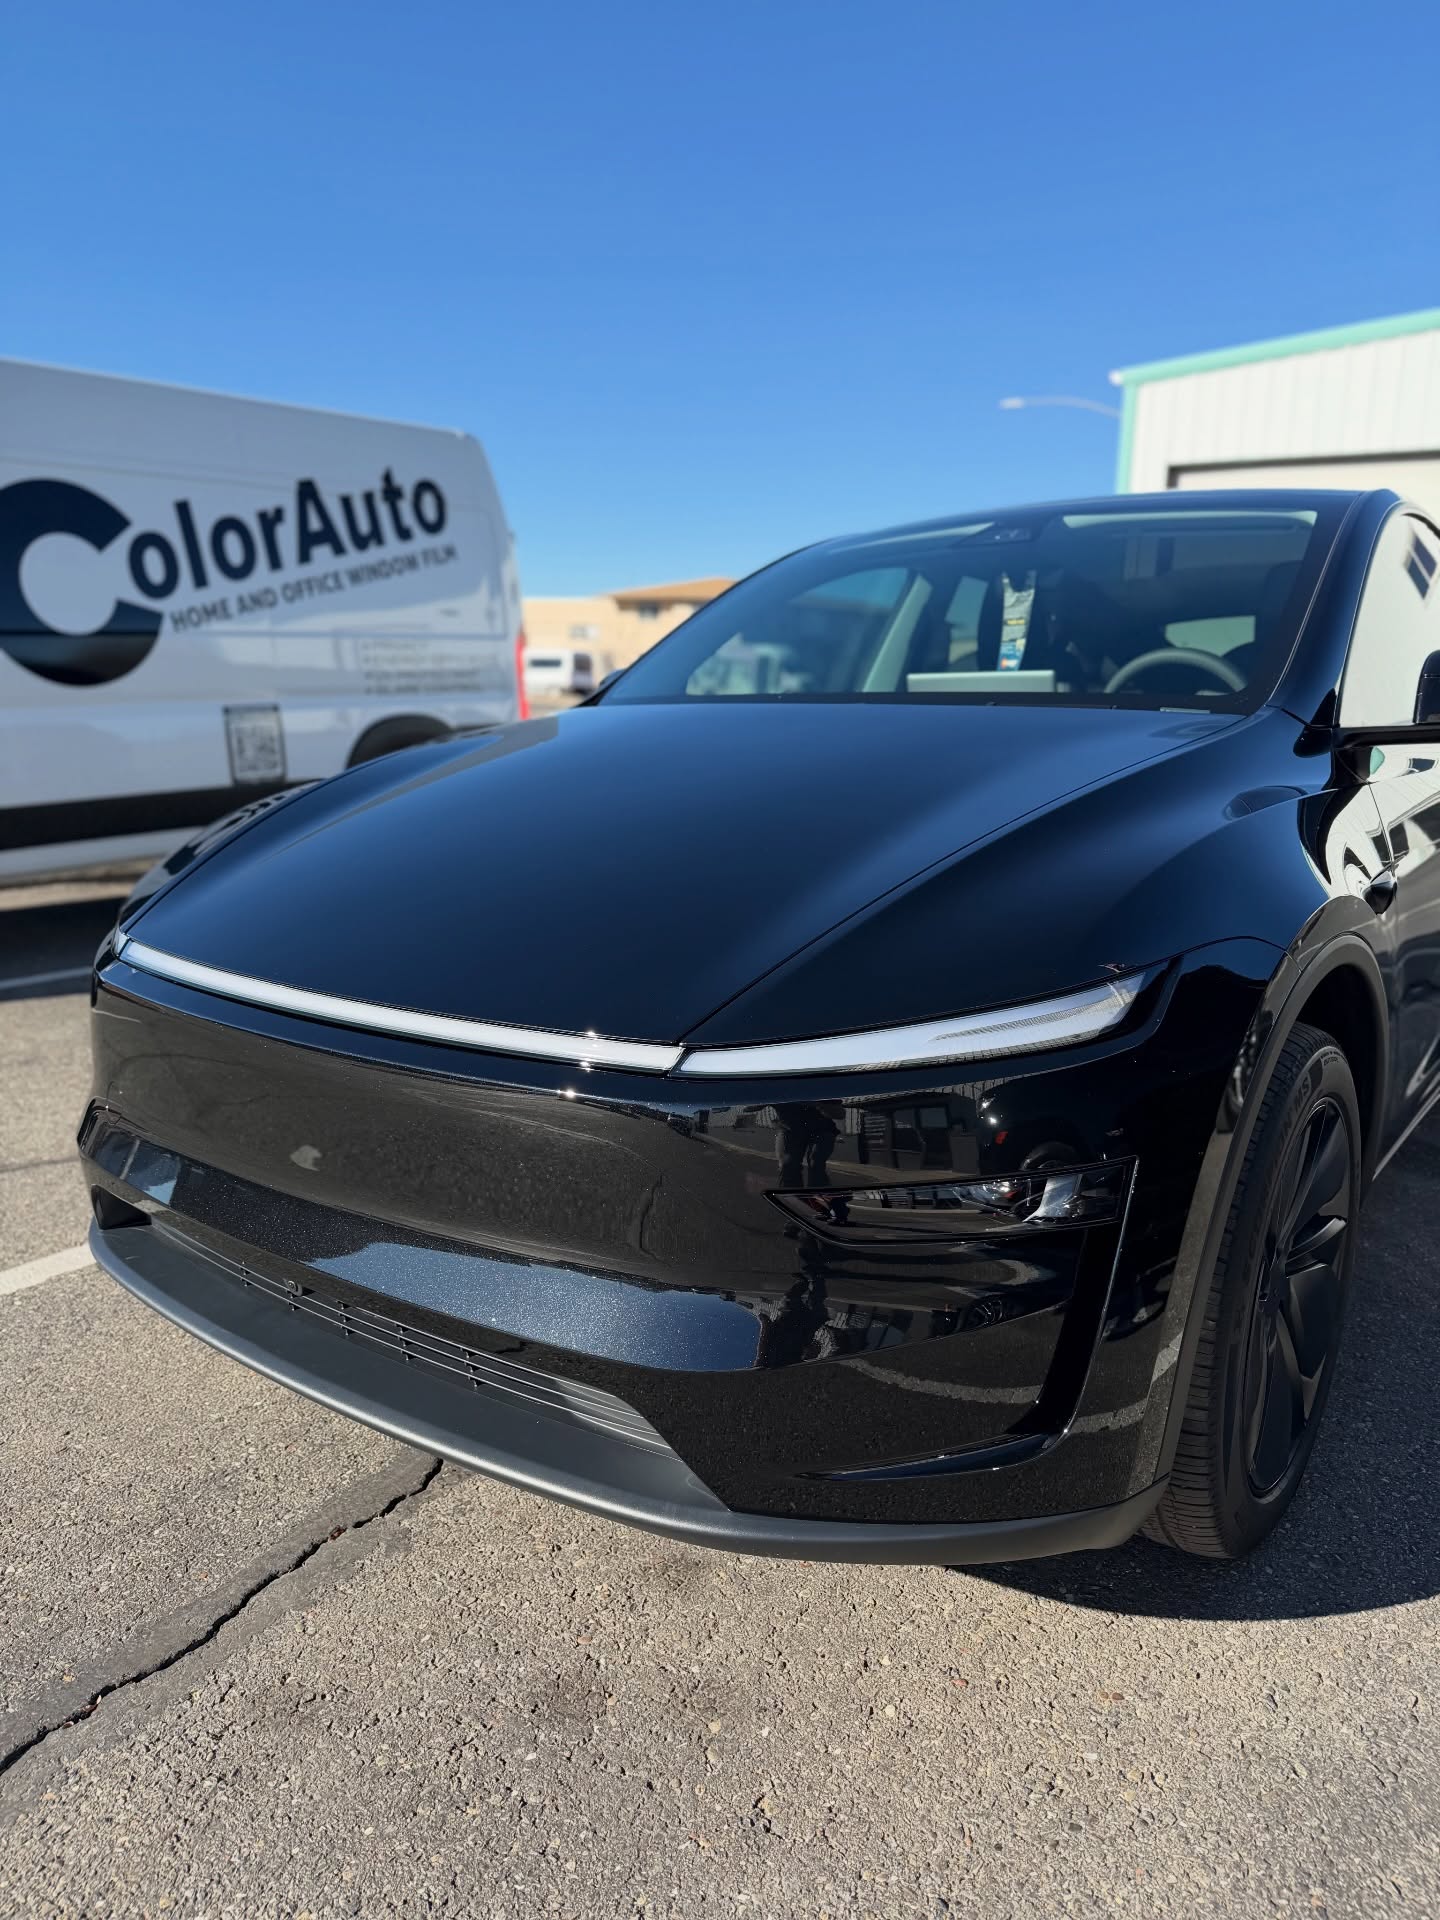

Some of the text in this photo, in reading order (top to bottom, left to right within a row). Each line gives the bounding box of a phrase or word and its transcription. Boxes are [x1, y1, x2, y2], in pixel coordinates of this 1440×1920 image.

[0, 467, 447, 687] ColorAuto
[170, 597, 232, 632] HOME
[237, 587, 279, 614] AND
[281, 570, 345, 603] OFFICE
[345, 553, 420, 585] WINDOW
